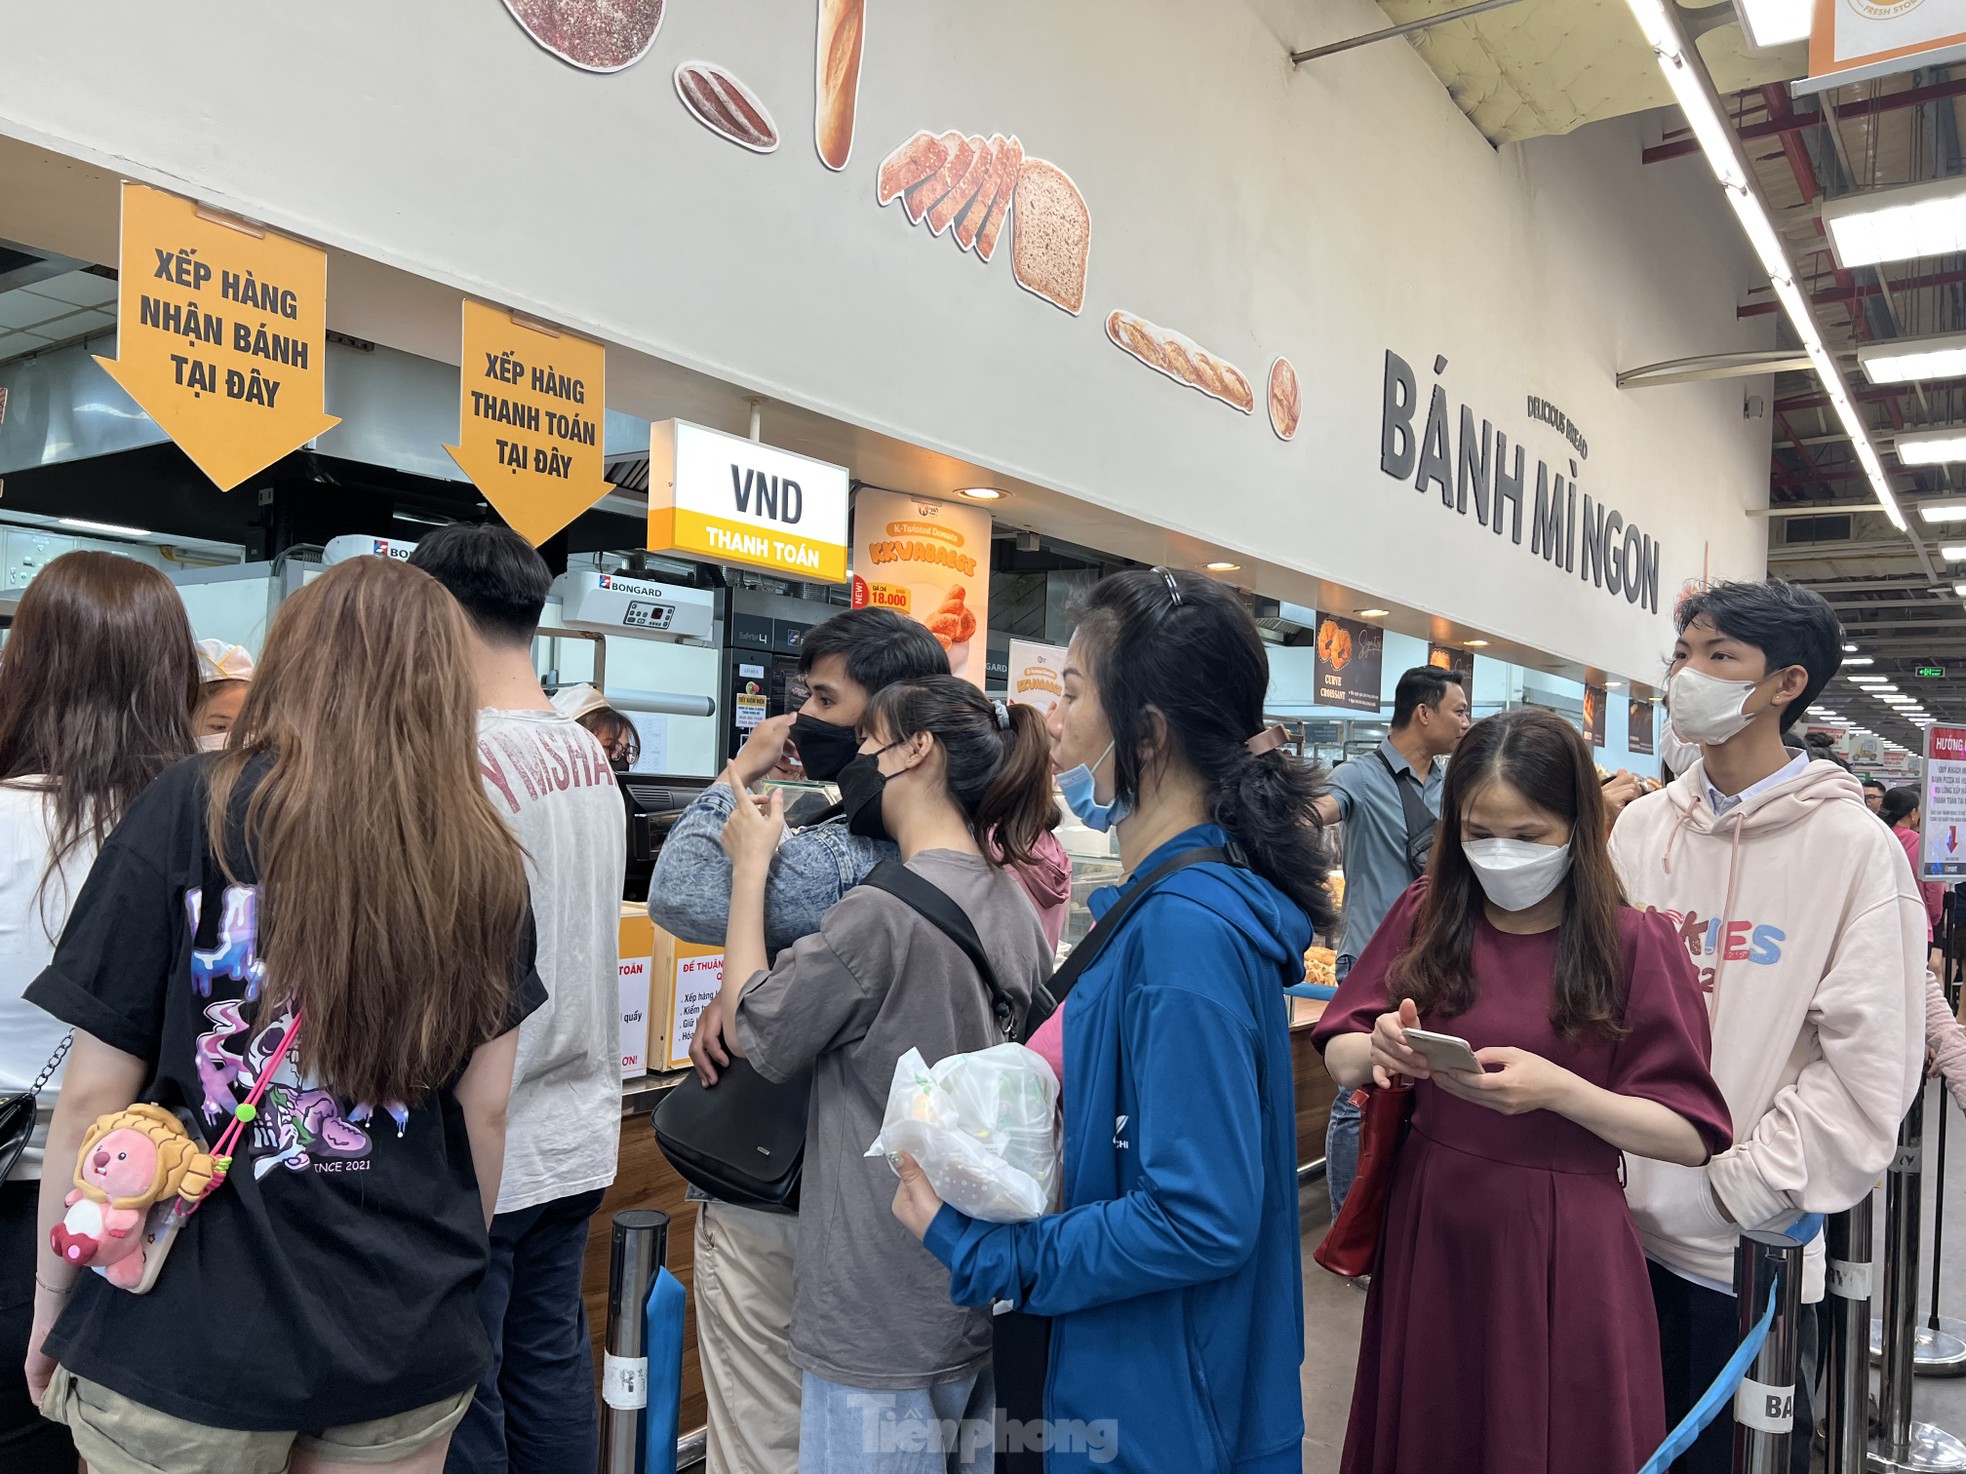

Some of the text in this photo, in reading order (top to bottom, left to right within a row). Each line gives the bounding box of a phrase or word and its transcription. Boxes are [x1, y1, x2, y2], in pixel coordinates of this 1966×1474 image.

[1863, 4, 1891, 16] FRESH
[154, 247, 298, 321] XẾP HÀNG
[140, 295, 309, 370] NHẬN BÁNH
[171, 353, 281, 409] TẠI ĐÂY
[484, 349, 586, 405] XẾP HÀNG
[471, 389, 596, 447] THANH TOÁN
[1527, 394, 1588, 461] DELICIOUS BREAD
[495, 438, 573, 480] TẠI ĐÂY
[1380, 348, 1660, 615] BÁNH MÌ NGON
[729, 463, 803, 526] VND
[893, 523, 958, 543] K-Twisted Donuts
[390, 548, 412, 559] BO
[705, 525, 820, 569] THANH TOÁN
[611, 582, 662, 598] BONGARD
[855, 581, 864, 605] NEW!
[871, 591, 907, 607] 18.000
[1324, 674, 1342, 687] CURVE
[1320, 687, 1346, 700] CROISSANT
[1935, 734, 1964, 752] HƯỚNG
[618, 962, 643, 976] TOÁN
[682, 960, 695, 973] ĐỂ
[684, 992, 697, 1004] Xếp
[345, 1160, 371, 1172] 2021
